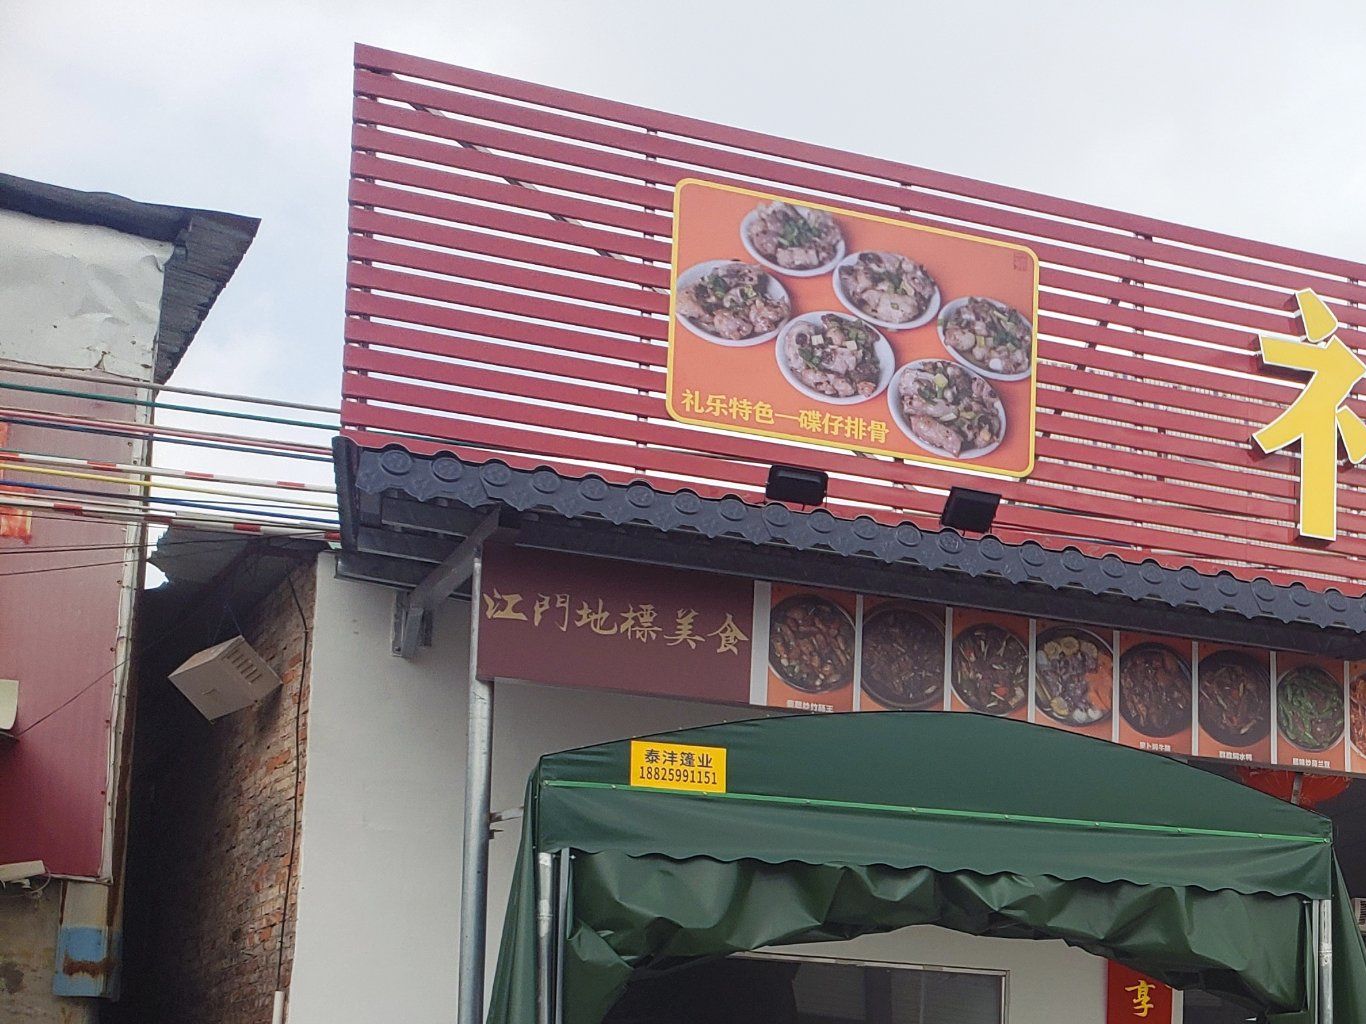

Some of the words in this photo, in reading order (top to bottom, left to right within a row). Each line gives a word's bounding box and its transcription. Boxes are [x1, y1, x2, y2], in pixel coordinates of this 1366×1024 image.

[483, 588, 749, 655] 江門地標美食
[640, 766, 717, 785] 18825991151
